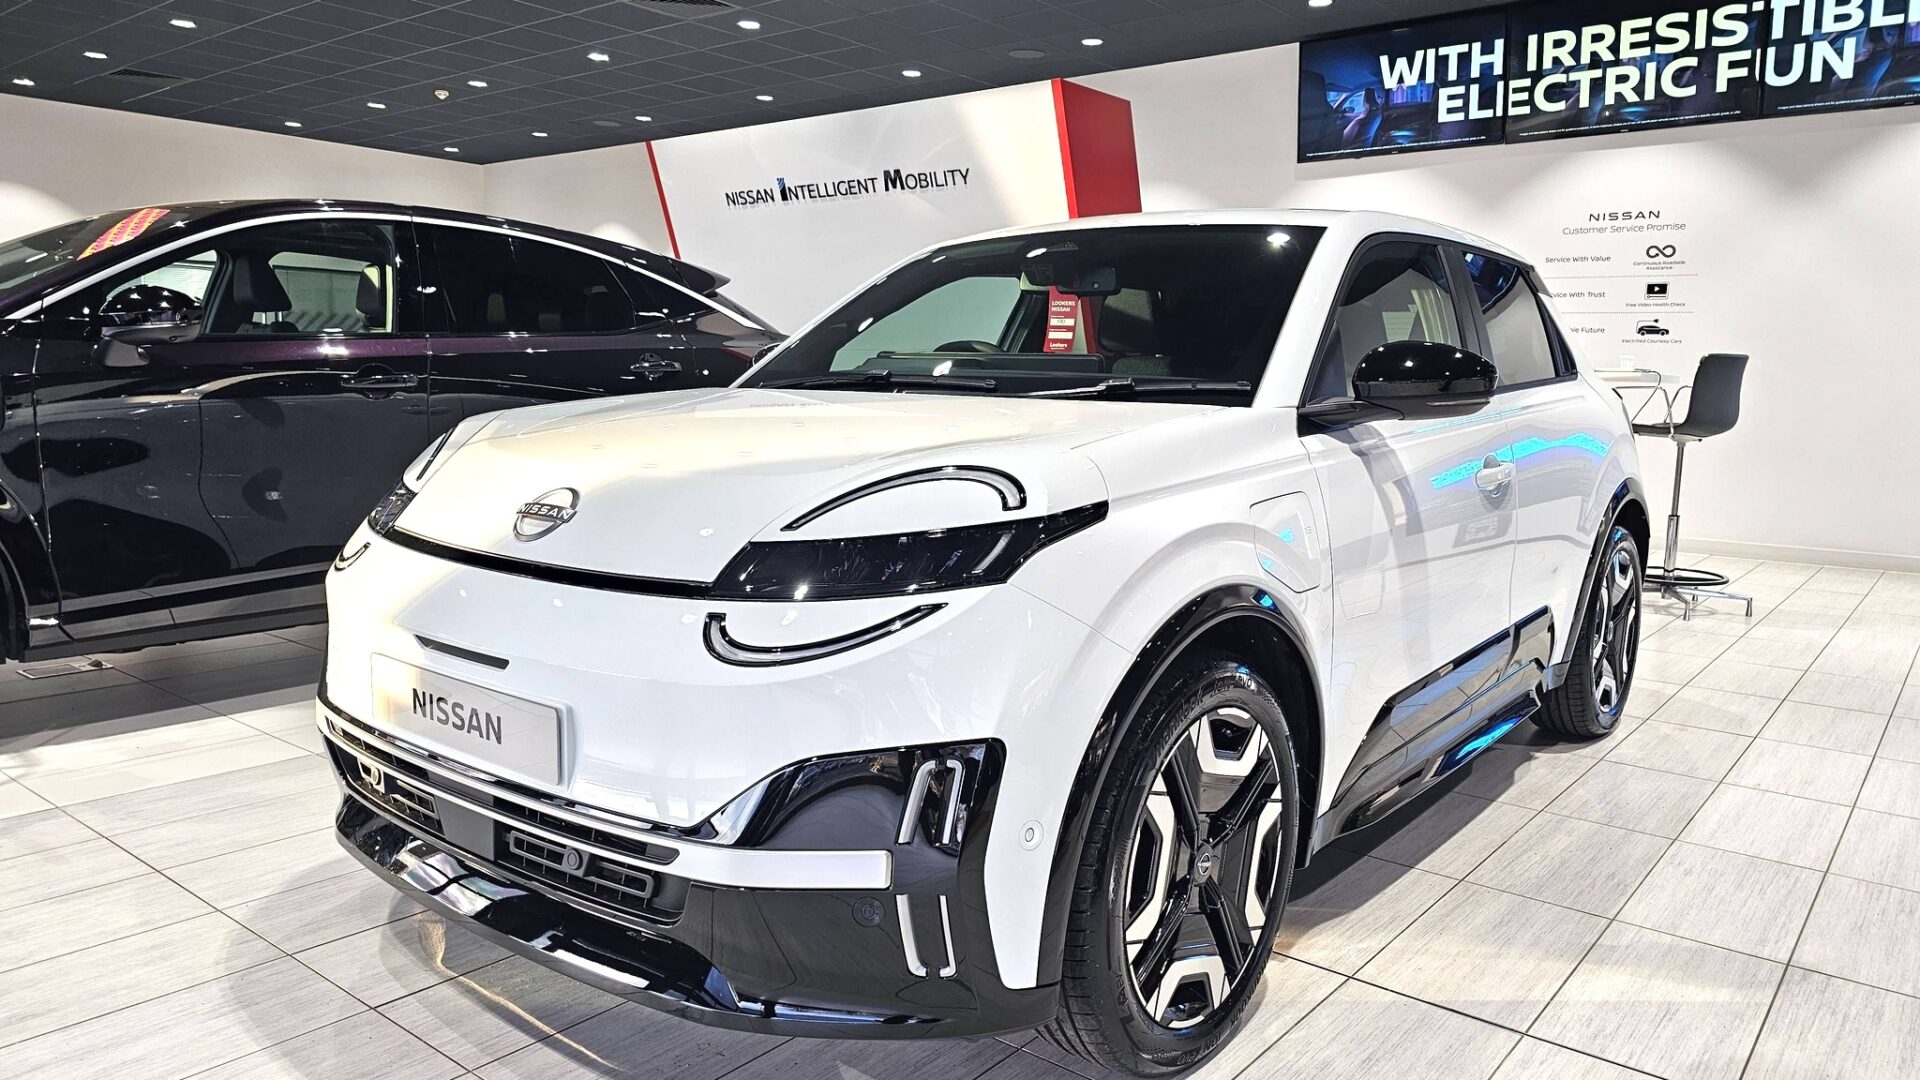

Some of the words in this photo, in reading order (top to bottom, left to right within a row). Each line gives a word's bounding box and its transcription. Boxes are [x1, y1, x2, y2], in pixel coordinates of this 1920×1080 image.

[1379, 38, 1504, 90] WITH
[1437, 56, 1698, 124] ELECTRIC
[1715, 37, 1857, 93] FUN
[725, 188, 775, 207] NISSAN
[776, 177, 878, 202] INTELLIGENT
[882, 168, 970, 192] MOBILITY
[1562, 225, 1608, 235] Customer
[1610, 224, 1645, 234] Service
[1646, 222, 1687, 232] Promise
[1588, 210, 1661, 222] NISSAN
[519, 503, 575, 520] NISSAN
[412, 687, 503, 745] NISSAN
